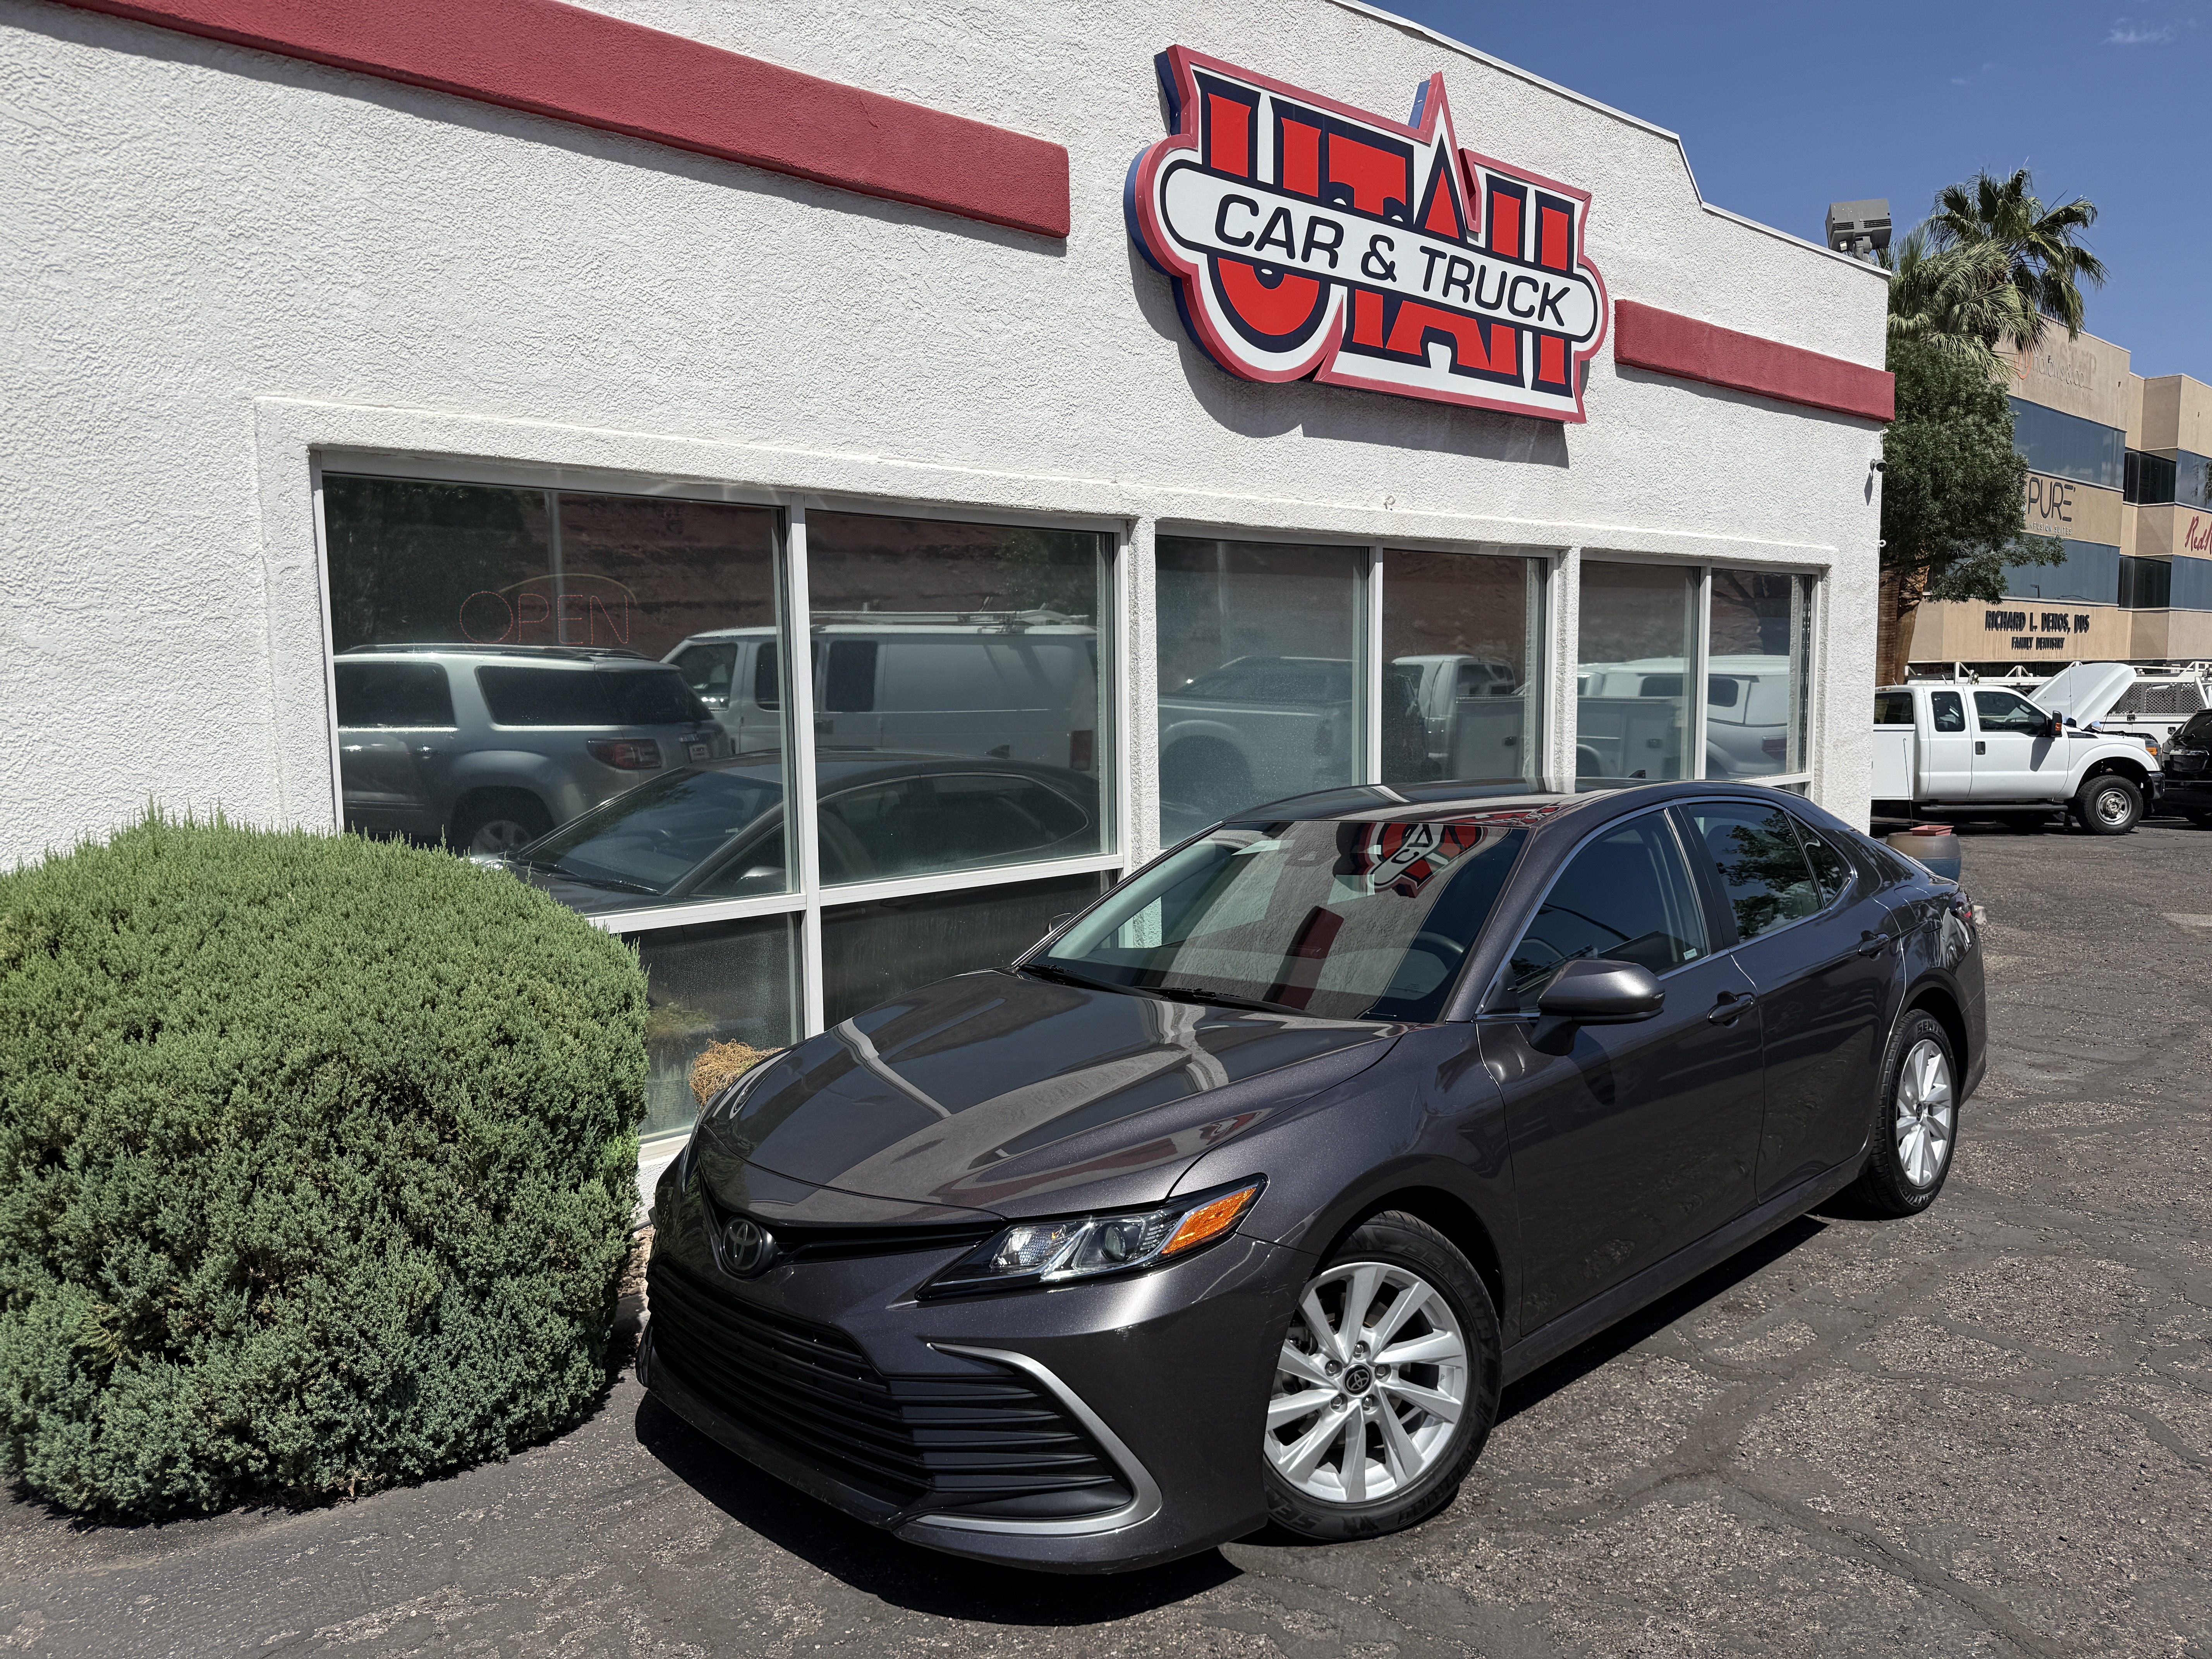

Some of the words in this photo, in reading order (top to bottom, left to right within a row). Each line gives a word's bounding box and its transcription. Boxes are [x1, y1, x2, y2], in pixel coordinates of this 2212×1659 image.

[1192, 70, 1576, 398] UTAH
[1214, 193, 1345, 269] CAR
[1360, 234, 1397, 282] &
[1419, 246, 1571, 328] TRUCK
[2028, 477, 2072, 522] PURE
[2027, 522, 2052, 532] INFUSION
[2054, 526, 2072, 535] SUITES
[460, 591, 629, 644] OPEN
[1985, 610, 2026, 632] RICHARD
[2029, 612, 2038, 632] L.
[2041, 613, 2071, 635] DENOS,
[2074, 615, 2090, 634] DDS
[2011, 637, 2034, 651] FAMILY
[2036, 637, 2065, 651] DENTISTRY
